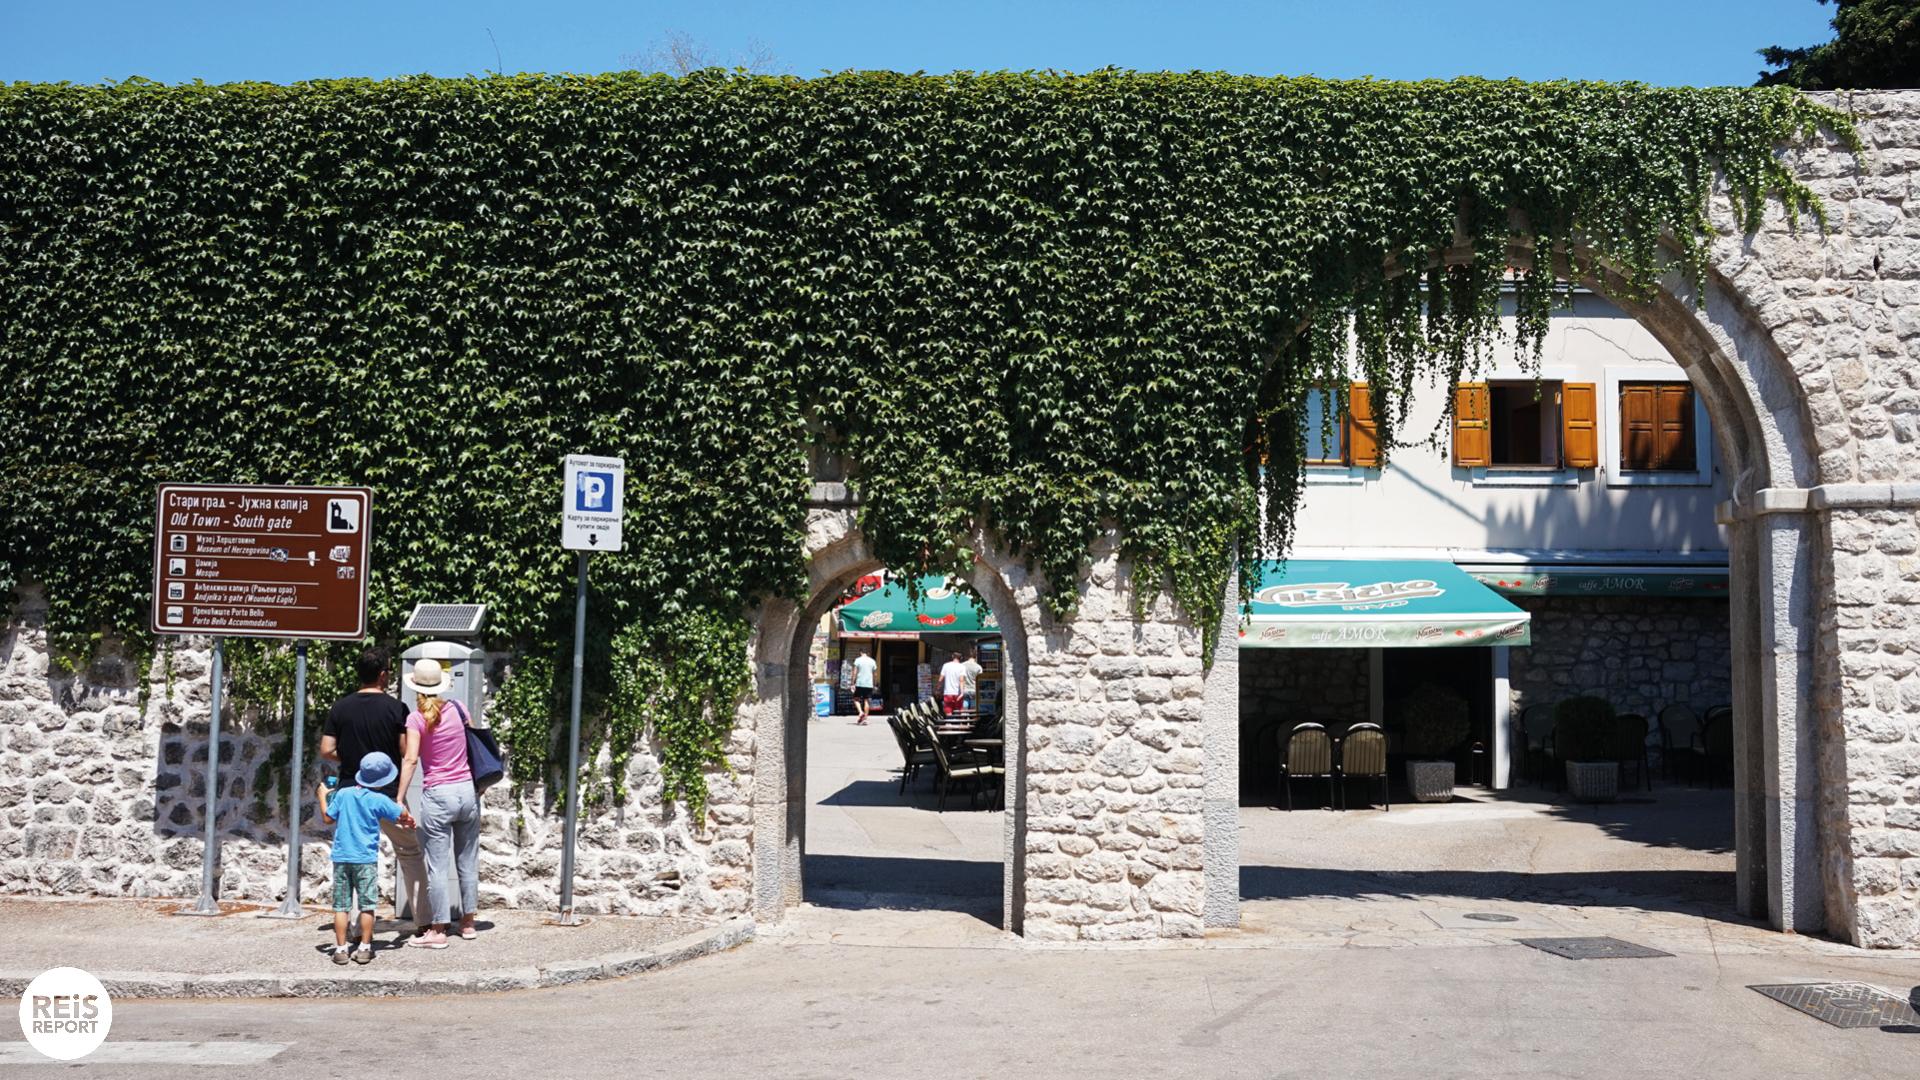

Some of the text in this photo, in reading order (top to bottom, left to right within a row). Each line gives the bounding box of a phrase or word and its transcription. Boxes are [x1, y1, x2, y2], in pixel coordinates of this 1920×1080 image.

[169, 493, 199, 510] Стари
[201, 496, 226, 511] град
[238, 495, 271, 512] Јужна
[274, 497, 309, 513] капија
[170, 512, 189, 526] Old
[192, 513, 221, 527] Town
[233, 514, 265, 528] South
[267, 516, 293, 531] gate
[196, 534, 256, 545] Музеј Херцеговине
[196, 545, 270, 556] Museum of Herzegovina
[195, 568, 219, 578] Mosque
[1578, 576, 1647, 592] caffe AMOR
[228, 585, 249, 594] капија
[278, 585, 297, 595] орао)
[194, 592, 298, 605] Andjelka's gate (Wounded Eagle)
[231, 608, 248, 617] Porto
[249, 608, 264, 617] Bello
[192, 616, 277, 627] Porto Bello Accommodation
[1311, 626, 1390, 642] caffe AMOR
